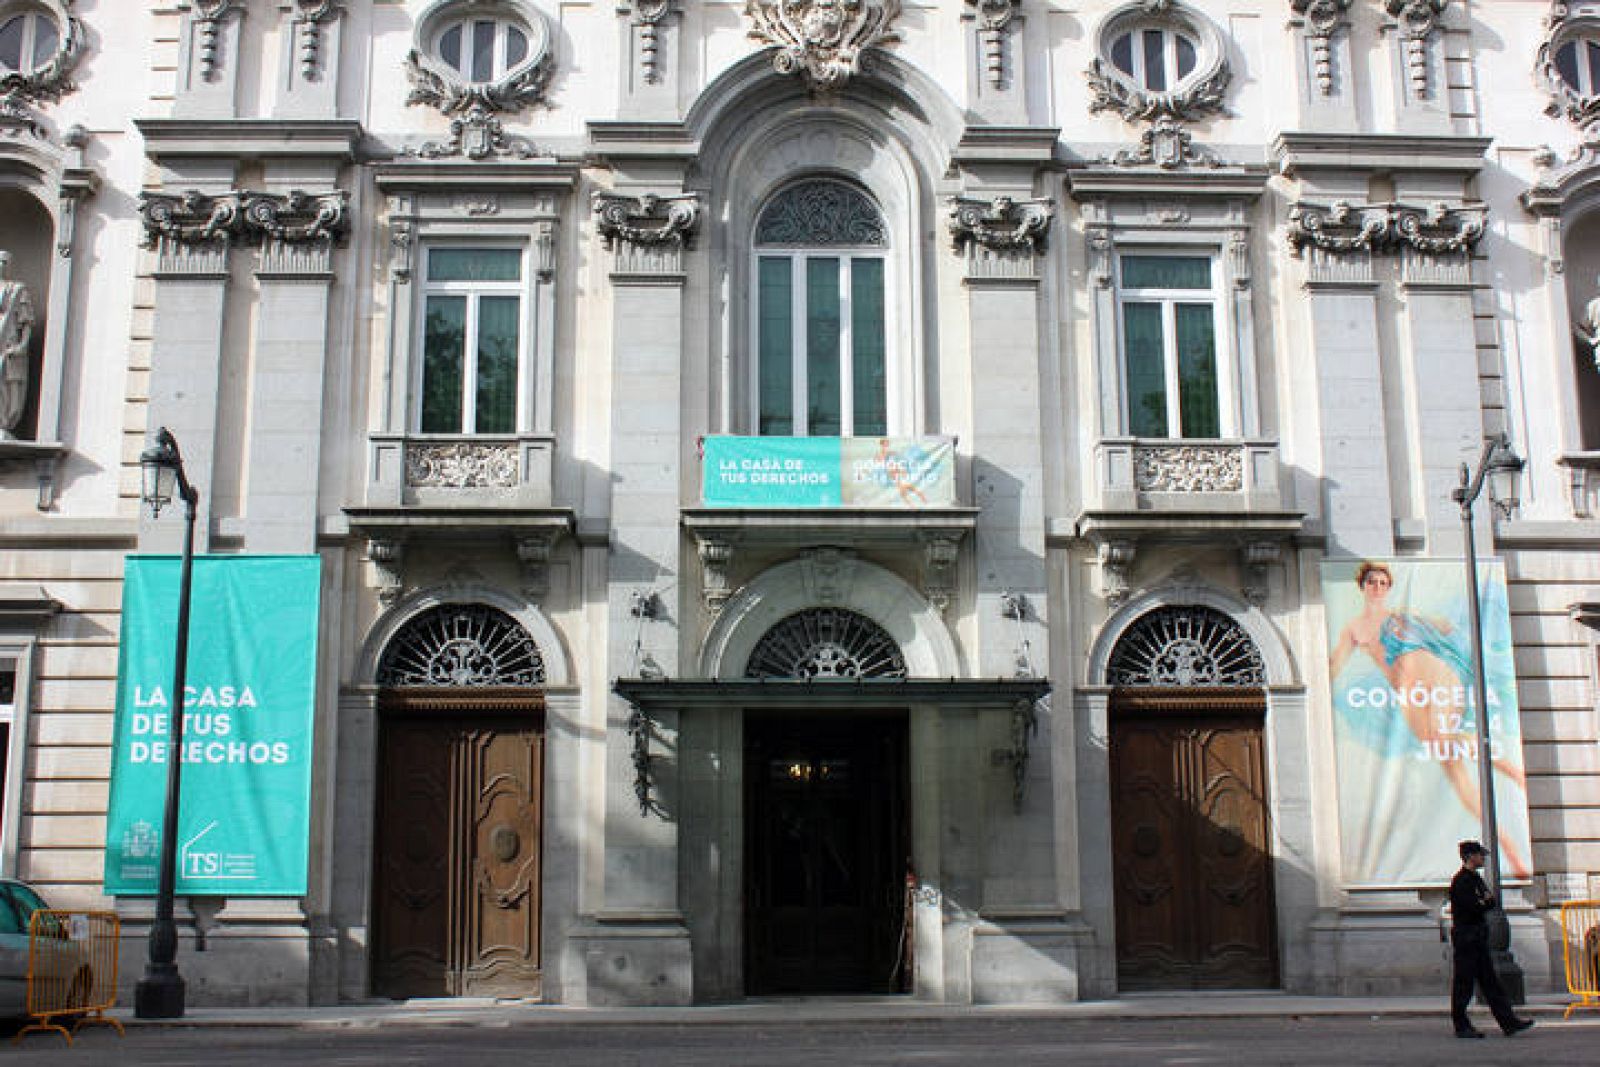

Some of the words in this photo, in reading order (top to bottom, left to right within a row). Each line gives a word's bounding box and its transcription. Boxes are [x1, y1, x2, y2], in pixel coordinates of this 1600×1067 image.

[719, 459, 738, 470] LA
[741, 459, 781, 470] CASA
[784, 459, 803, 470] DE
[720, 472, 747, 483] TUS
[750, 472, 830, 483] DERECHOS
[134, 685, 167, 708] LA
[183, 685, 257, 708] CASA
[132, 713, 168, 735] DE
[181, 713, 232, 736] TUS
[188, 852, 218, 874] TS
